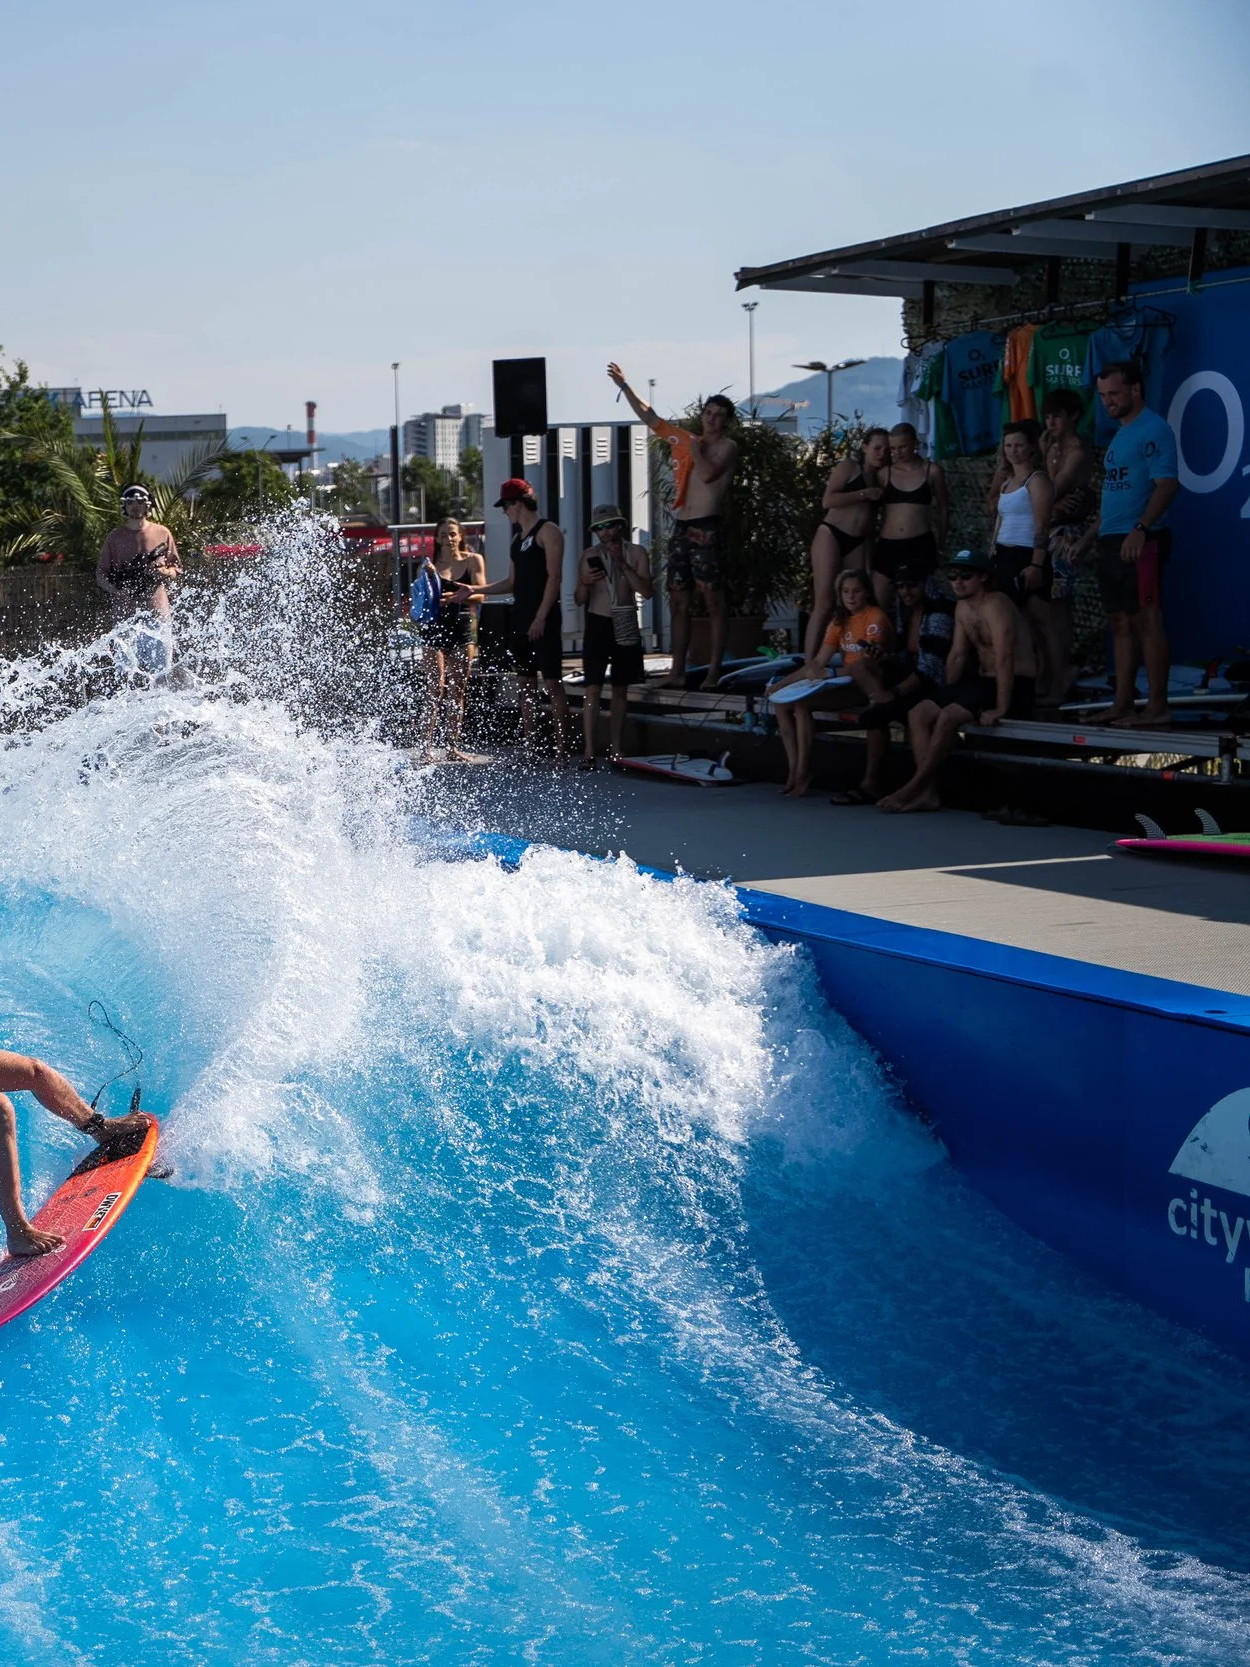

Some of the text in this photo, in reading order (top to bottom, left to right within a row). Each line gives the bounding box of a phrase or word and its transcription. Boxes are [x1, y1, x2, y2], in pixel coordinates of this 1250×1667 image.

[1045, 364, 1083, 377] SURF
[1167, 370, 1250, 519] O
[1167, 1187, 1250, 1264] city
